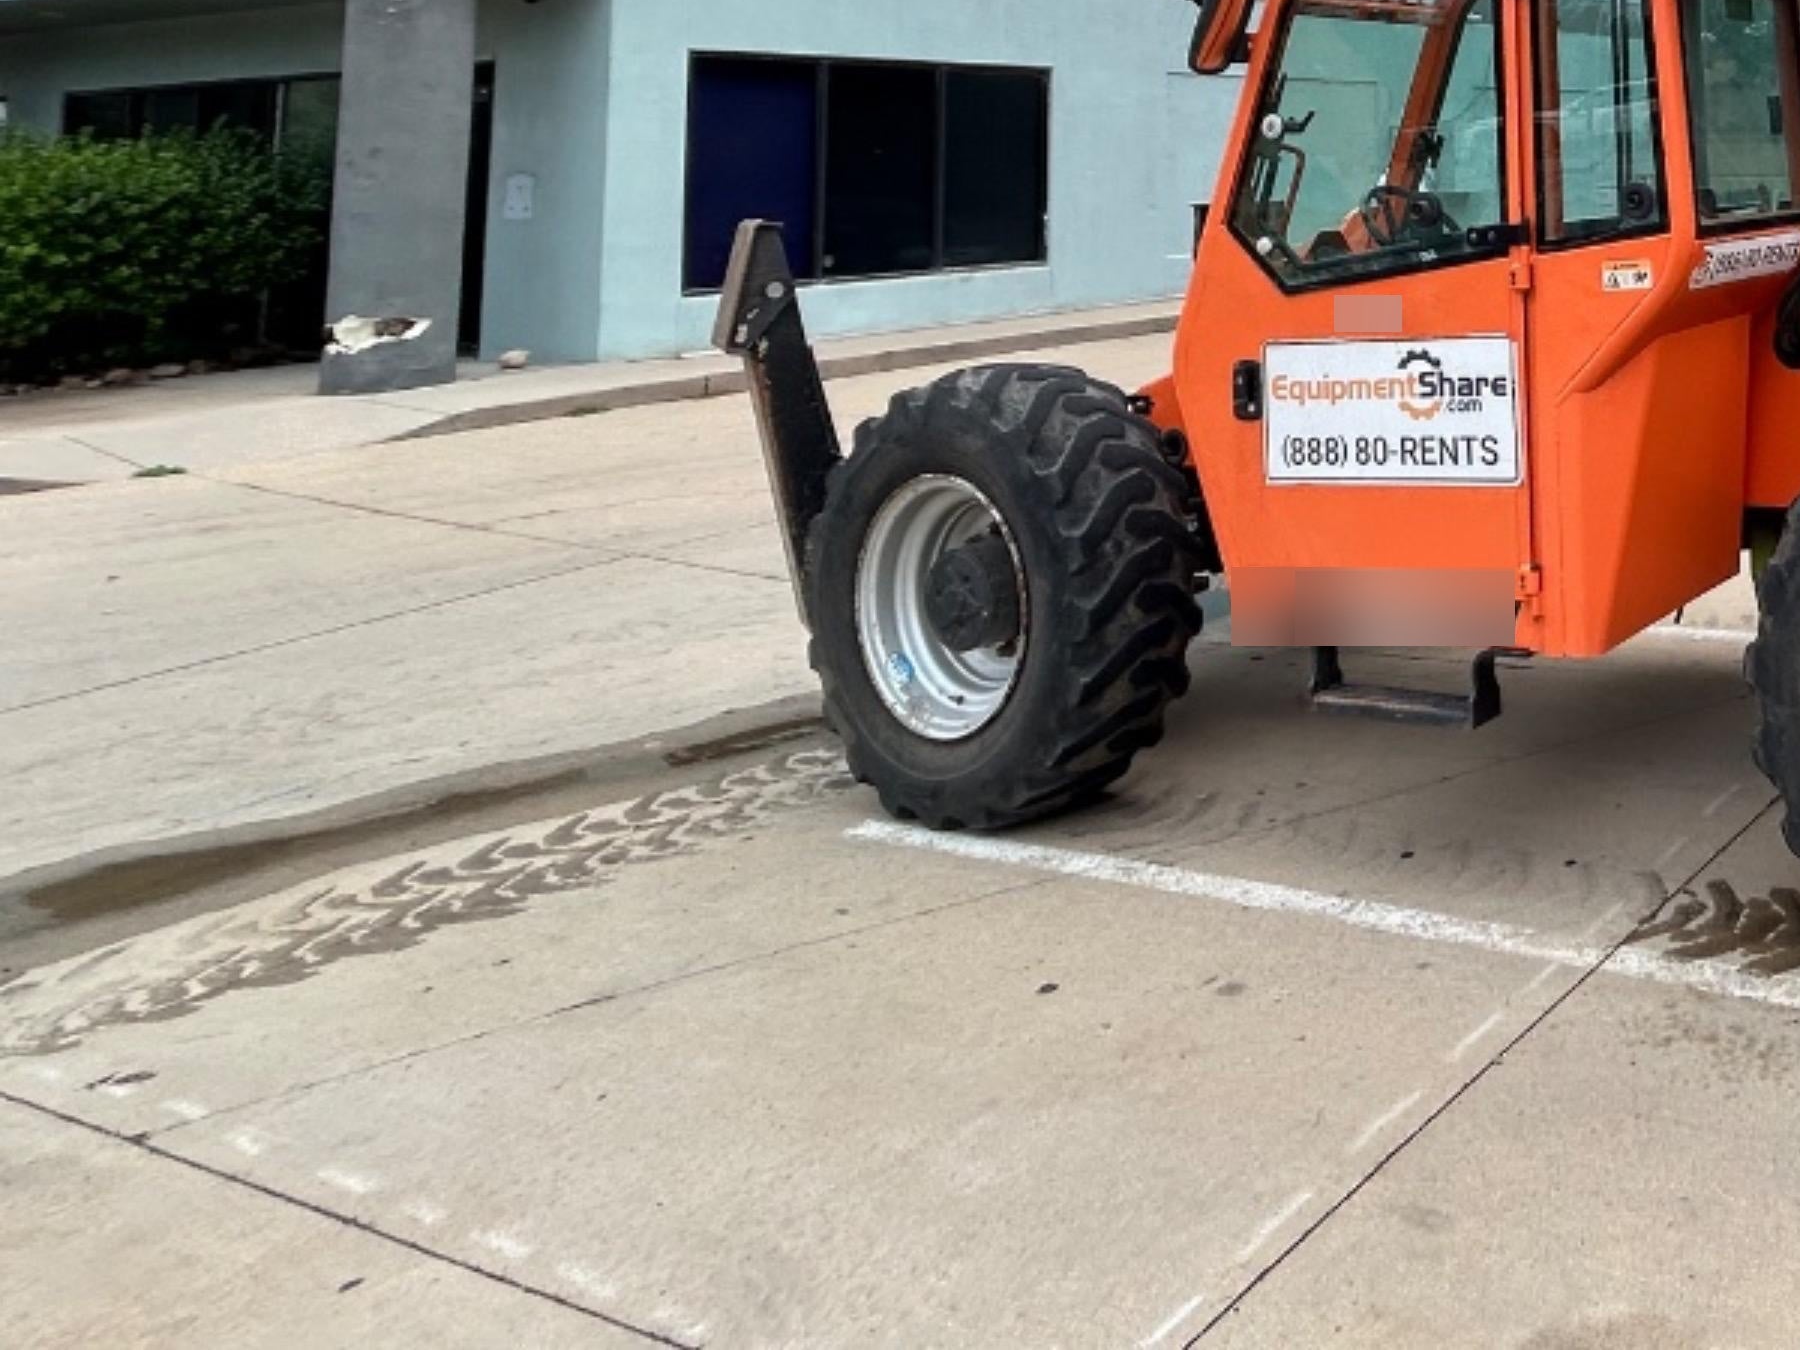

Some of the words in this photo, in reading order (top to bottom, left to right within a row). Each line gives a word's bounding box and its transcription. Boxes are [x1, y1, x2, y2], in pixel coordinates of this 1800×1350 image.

[1271, 371, 1508, 406] EquipmentShare
[1283, 434, 1348, 468] (888)
[1354, 434, 1500, 467] 80-RENTS
